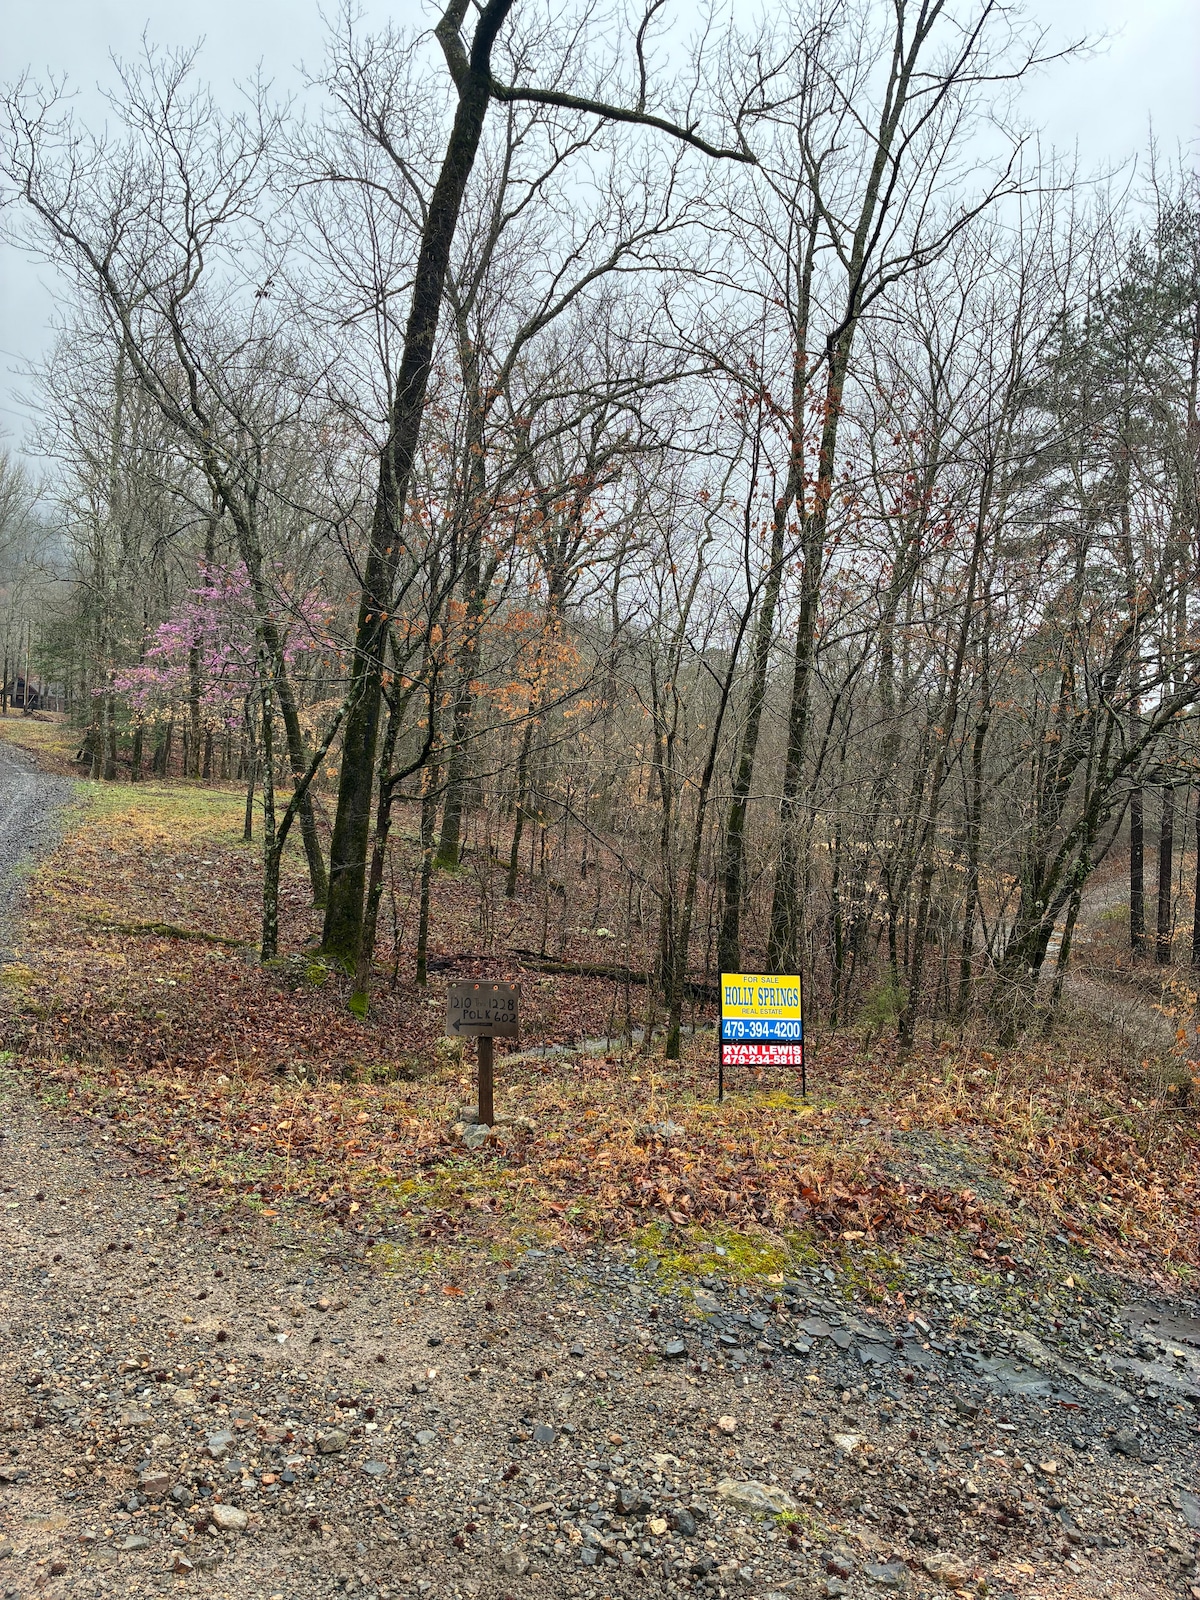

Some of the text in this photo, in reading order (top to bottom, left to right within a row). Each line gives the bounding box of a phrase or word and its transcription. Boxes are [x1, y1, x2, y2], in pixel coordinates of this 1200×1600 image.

[725, 986, 798, 1007] HOLLY SPRINGS
[488, 998, 514, 1011] 1228
[463, 1009, 517, 1023] POLK 602
[724, 1021, 800, 1038] 479-394-4200
[723, 1045, 801, 1055] RYAN LEWIS
[723, 1055, 801, 1065] 479-234-5818
